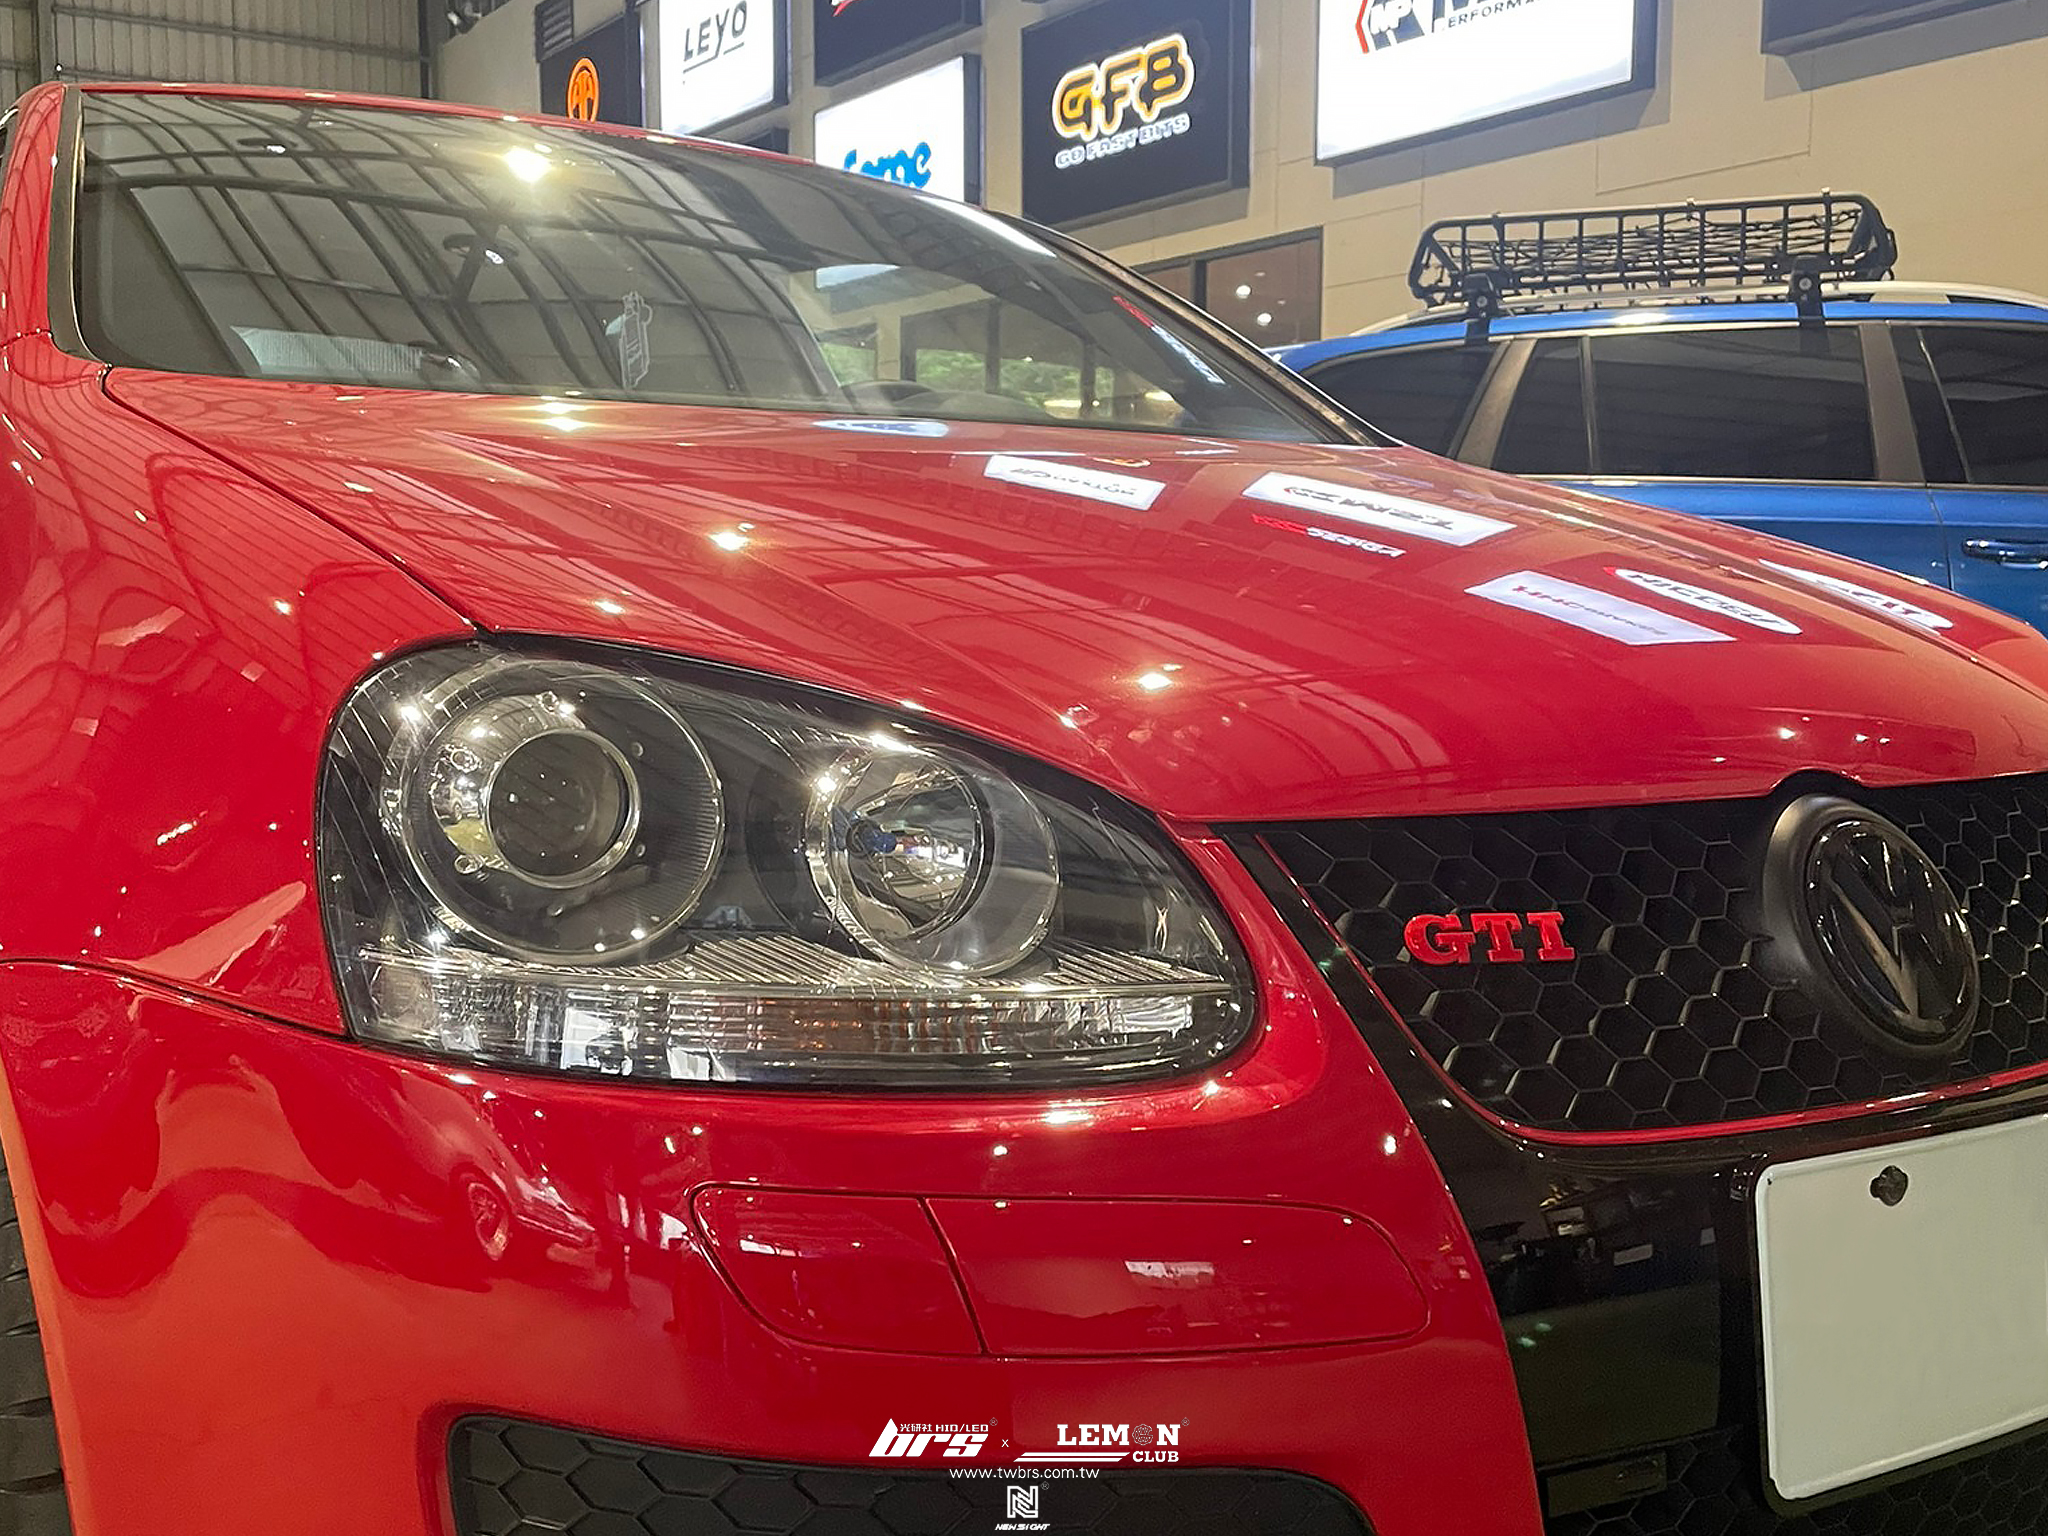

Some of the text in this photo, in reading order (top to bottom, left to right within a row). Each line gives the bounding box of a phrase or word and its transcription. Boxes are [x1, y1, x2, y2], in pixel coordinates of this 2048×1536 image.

[683, 0, 747, 63] LEYO
[1052, 33, 1195, 142] GFB
[1055, 113, 1191, 169] GO FAST BITS
[1403, 911, 1575, 965] GTI
